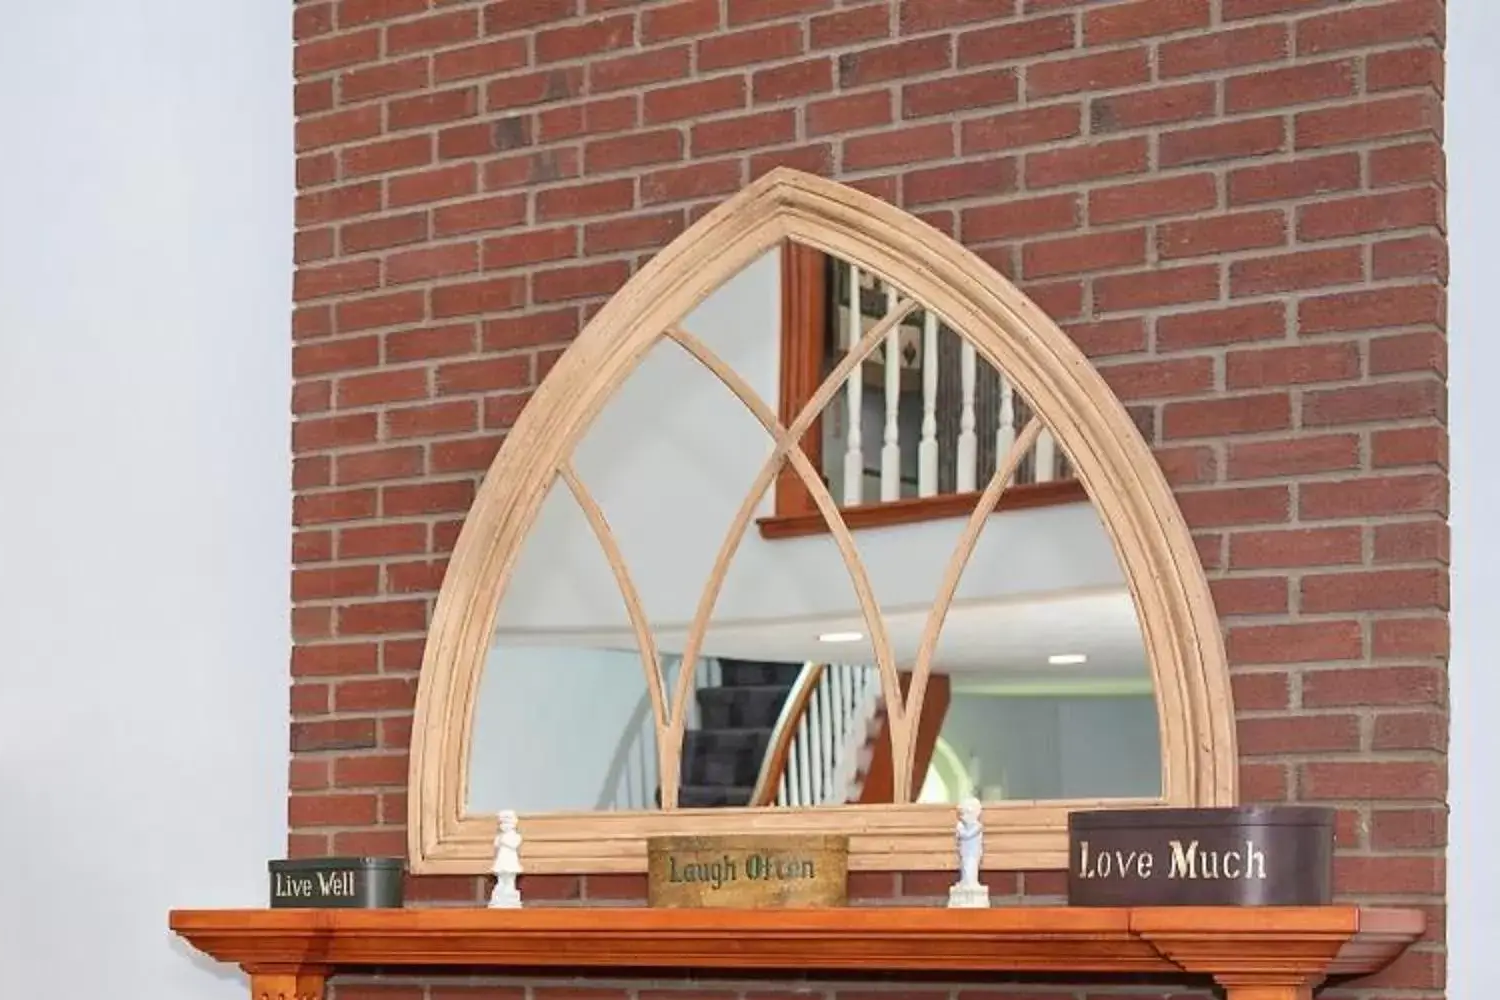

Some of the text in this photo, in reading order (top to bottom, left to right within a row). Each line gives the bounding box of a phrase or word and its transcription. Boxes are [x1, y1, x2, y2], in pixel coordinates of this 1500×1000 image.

[669, 853, 815, 888] Laugh Often
[1079, 840, 1267, 878] Love Much
[276, 871, 355, 896] Live Well
